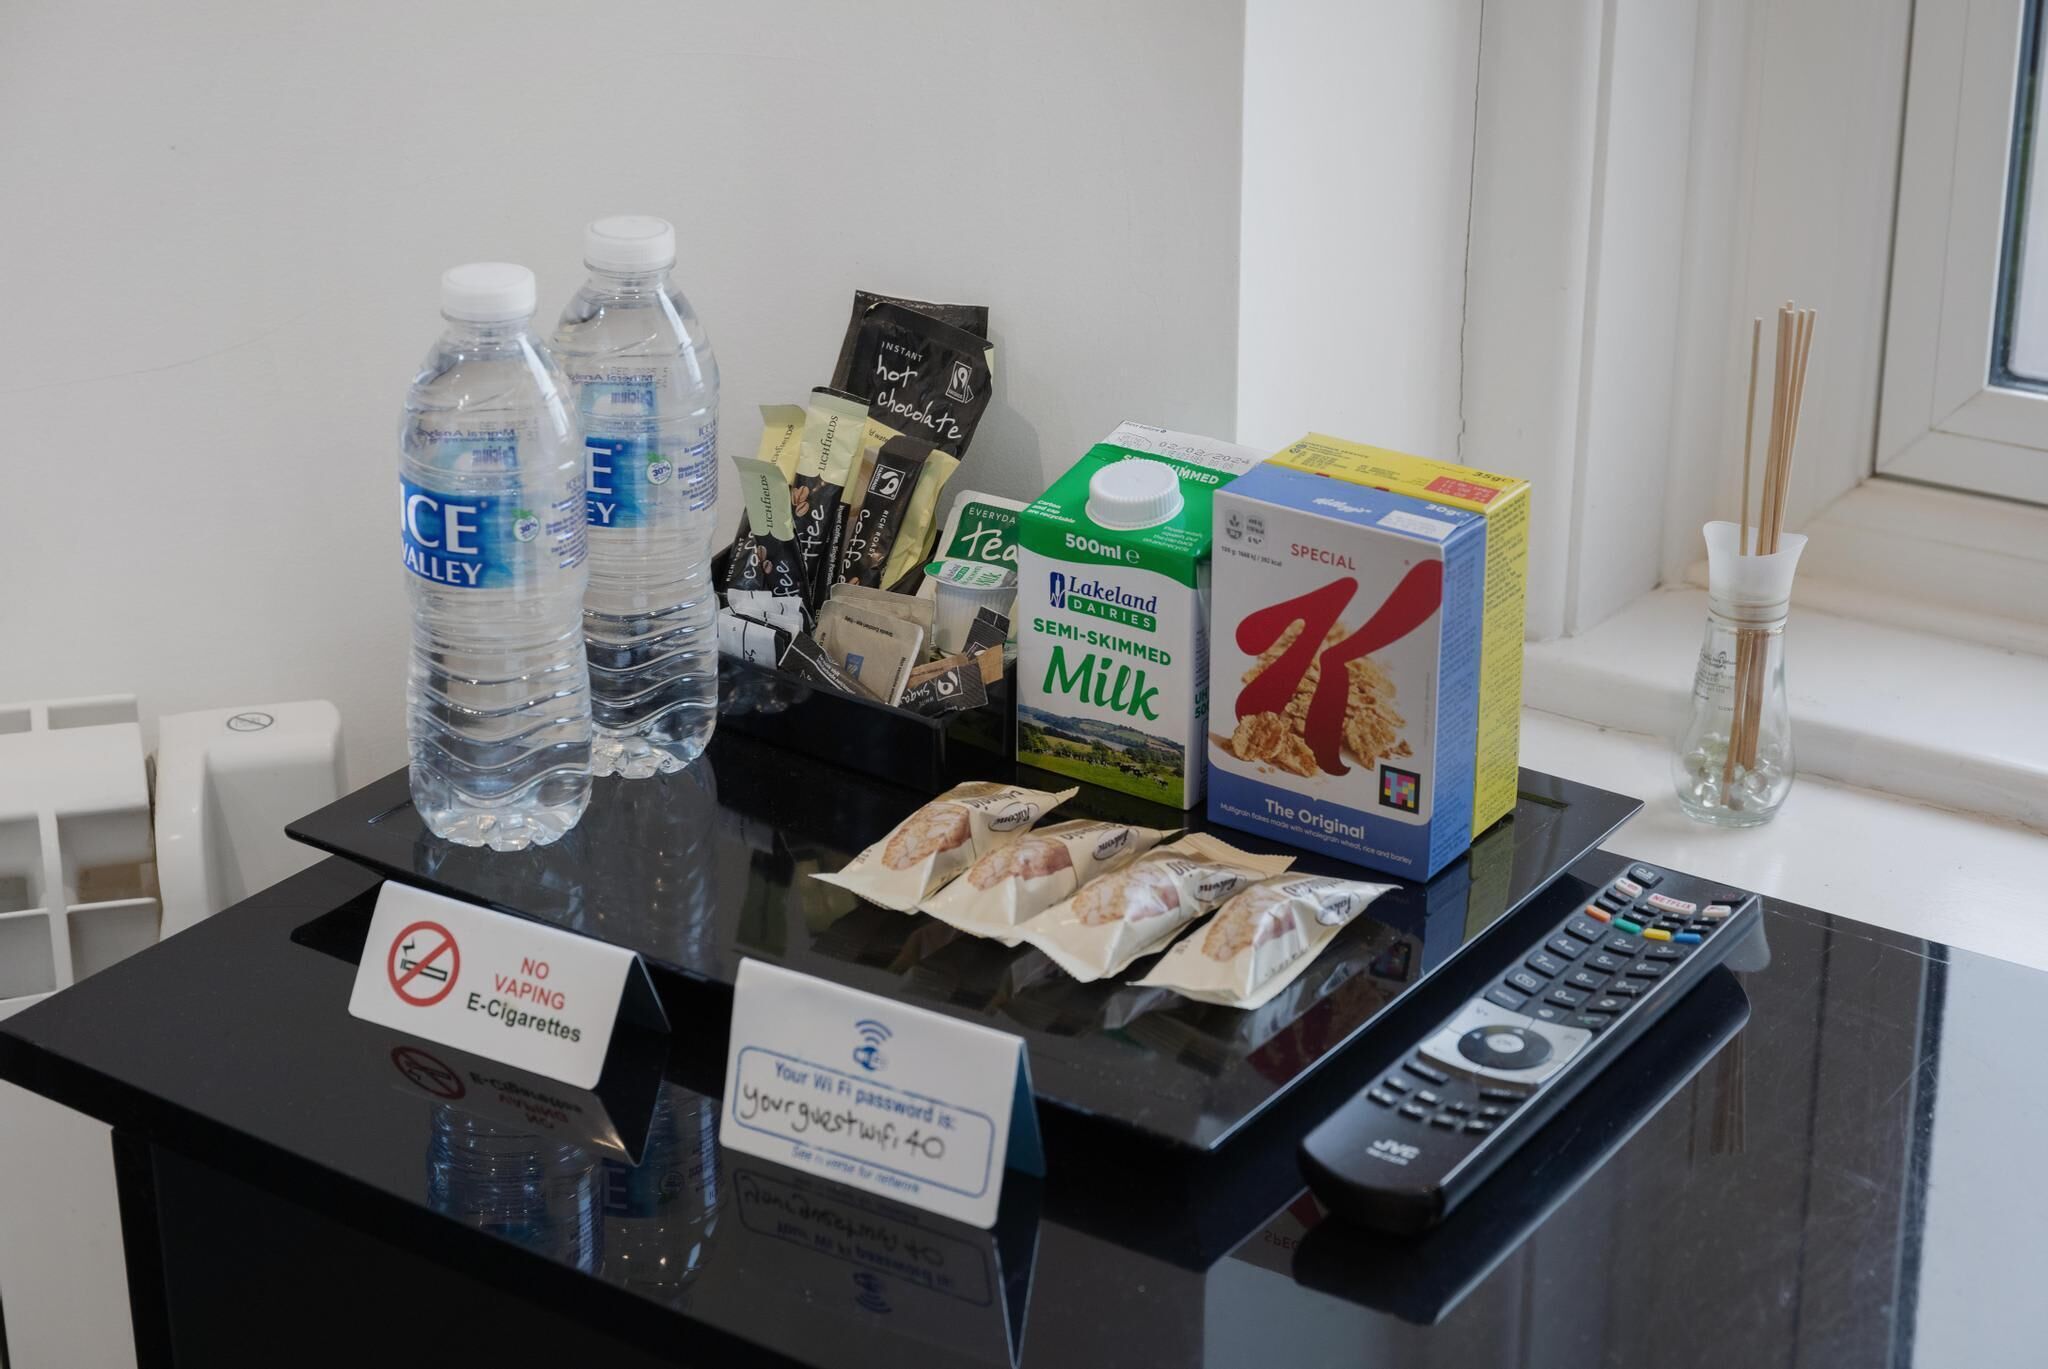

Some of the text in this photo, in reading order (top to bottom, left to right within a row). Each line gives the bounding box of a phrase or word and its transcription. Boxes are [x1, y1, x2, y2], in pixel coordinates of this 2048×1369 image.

[881, 341, 924, 362] INSTANT
[876, 354, 918, 388] hot
[877, 387, 962, 439] chocolate
[968, 507, 1016, 524] EVERYDA
[960, 521, 1018, 561] tea
[1065, 533, 1122, 561] 500ml
[1290, 543, 1356, 570] SPECIAL
[1068, 575, 1157, 614] Lakeland
[1073, 600, 1151, 629] DAIRIES
[1033, 617, 1172, 666] SEMI-SKIMMED
[901, 682, 931, 704] suga
[1042, 645, 1159, 721] Milk
[1264, 798, 1365, 840] The Original
[1304, 826, 1340, 845] wholegrain
[1376, 847, 1390, 859] and
[1390, 851, 1413, 866] barley
[1652, 894, 1692, 911] NETFLIX
[520, 957, 550, 980] NO
[494, 973, 566, 1011] VAPING
[466, 991, 581, 1043] E-Cigarettes
[775, 1061, 808, 1085] Your
[813, 1074, 833, 1093] Wi
[837, 1080, 850, 1097] Fi
[854, 1089, 934, 1124] password
[791, 1144, 813, 1162] See
